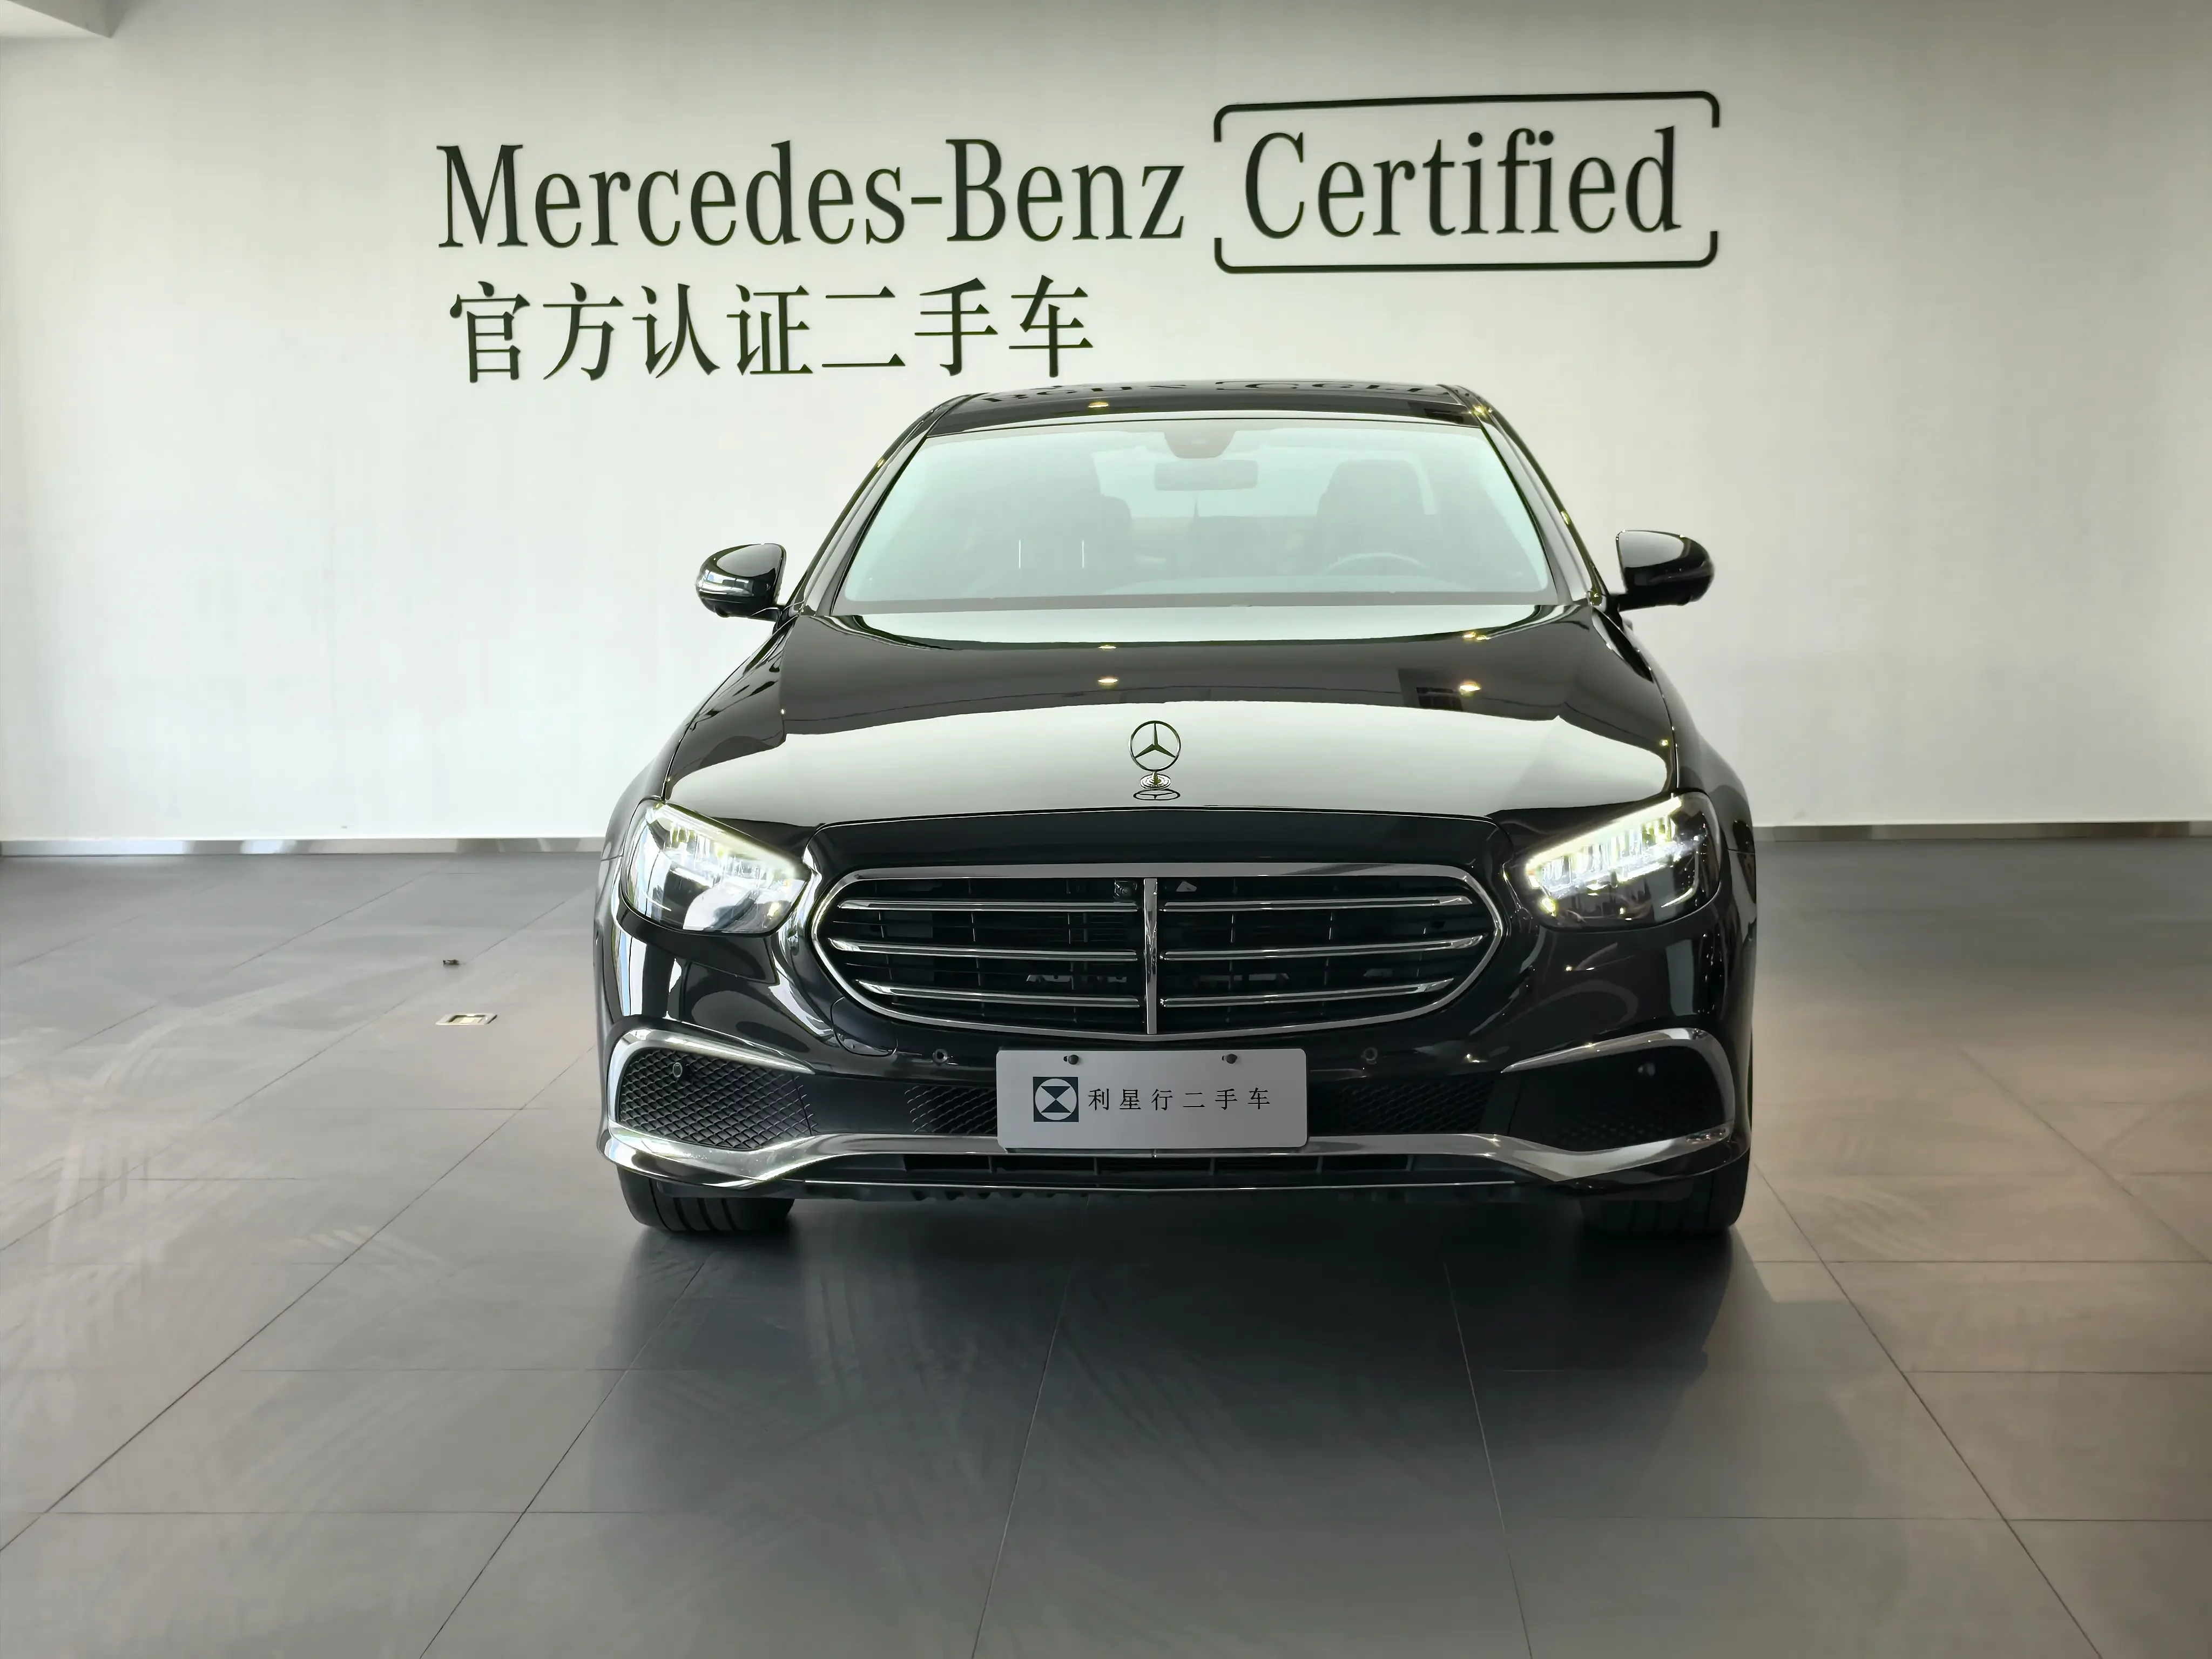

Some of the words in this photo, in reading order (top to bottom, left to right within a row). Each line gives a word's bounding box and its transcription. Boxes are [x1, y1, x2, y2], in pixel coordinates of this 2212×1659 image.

[435, 138, 1185, 248] Mercedes-Benz
[1245, 125, 1682, 240] Certified
[449, 274, 1094, 383] 官方认证二手车
[1087, 1087, 1271, 1111] 利星行二手车
